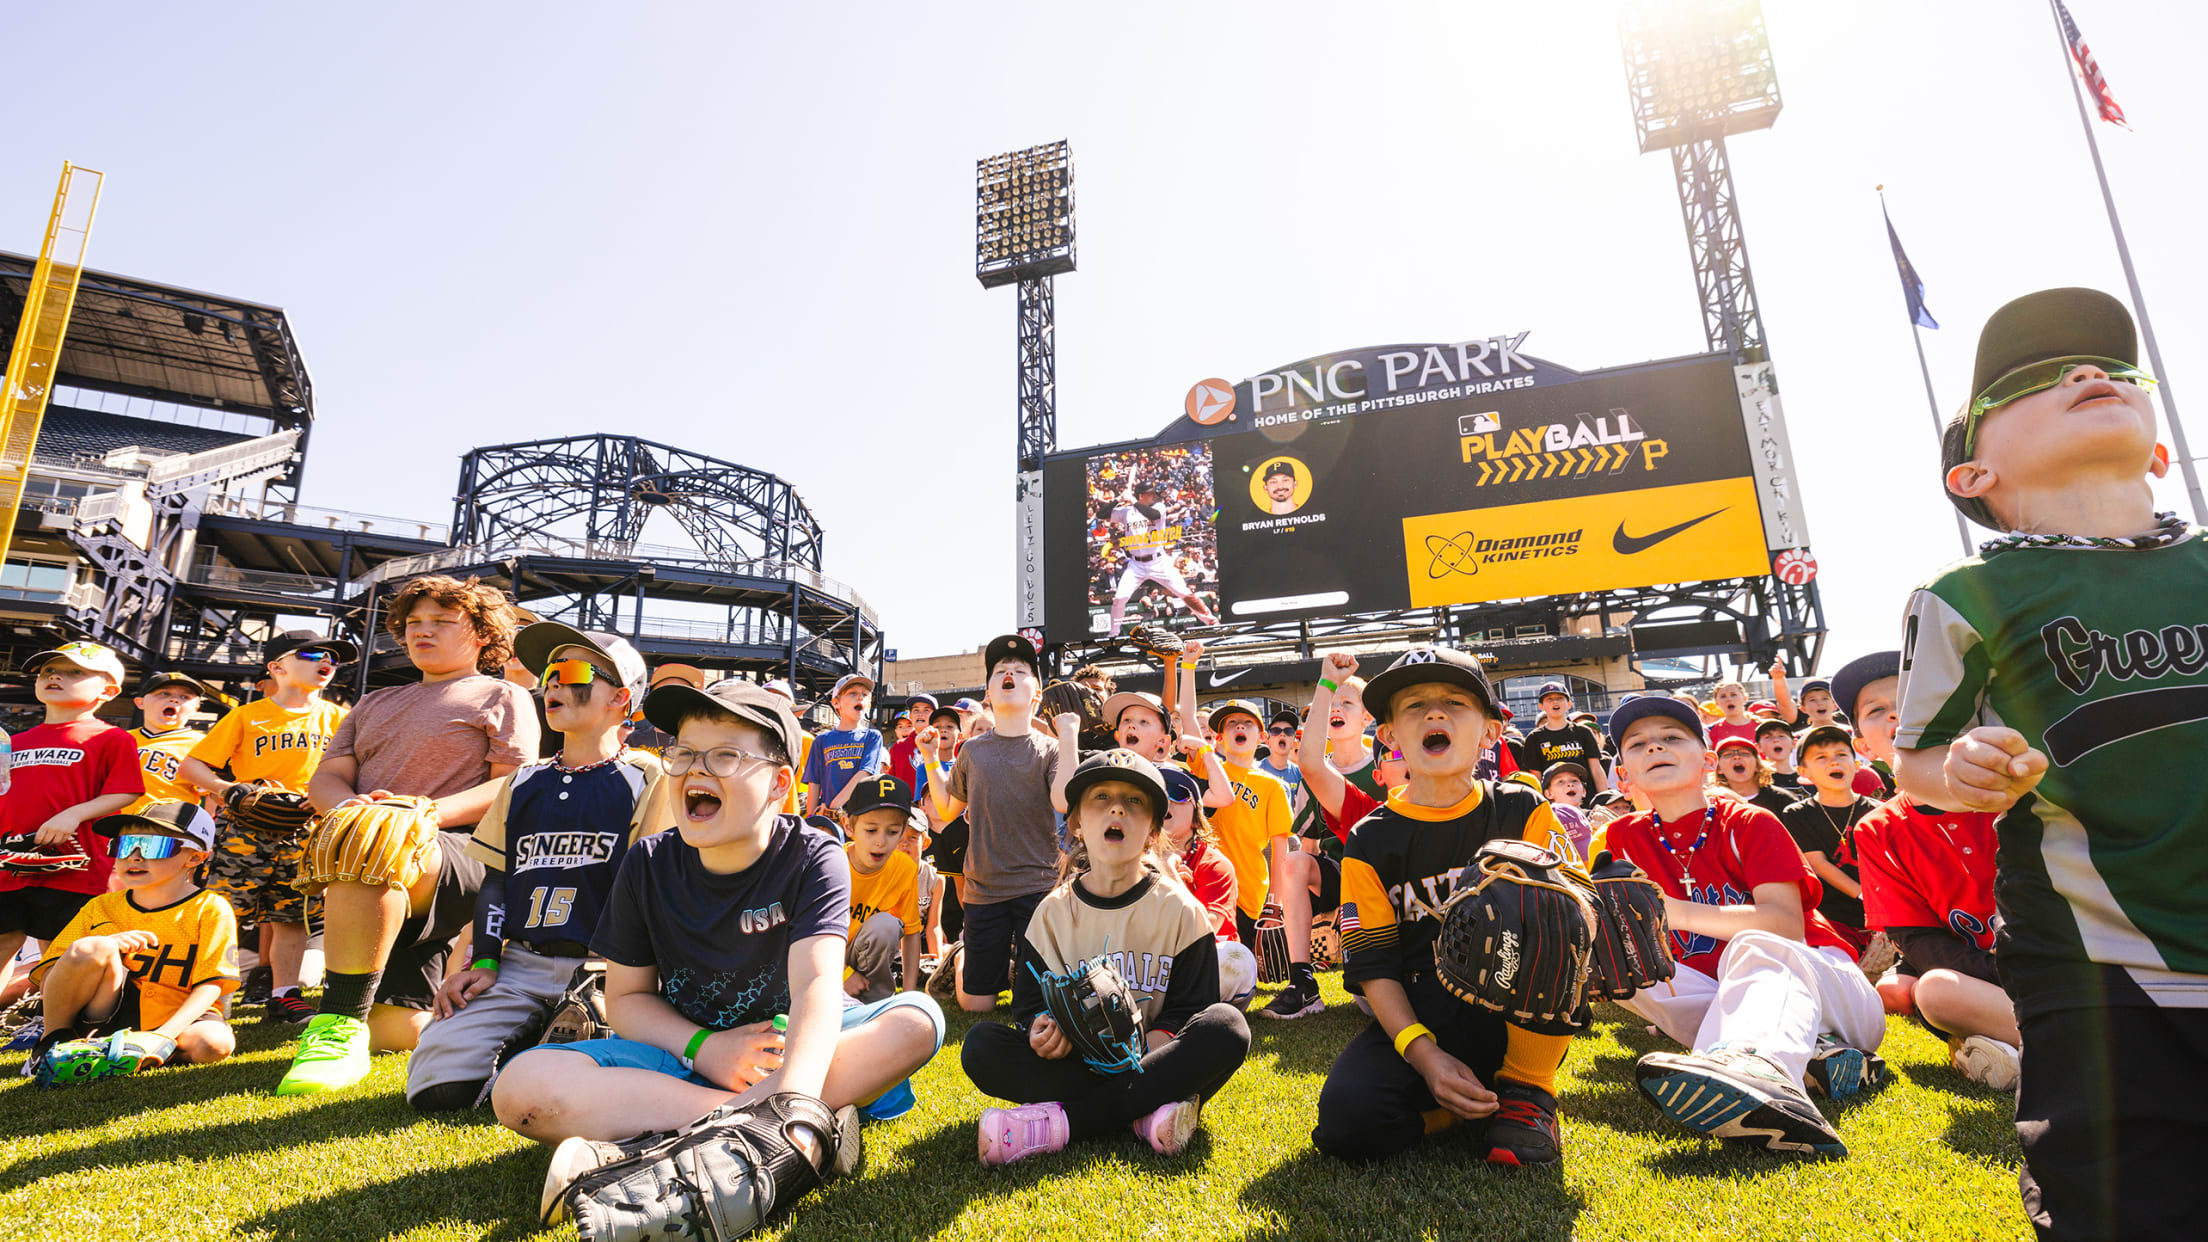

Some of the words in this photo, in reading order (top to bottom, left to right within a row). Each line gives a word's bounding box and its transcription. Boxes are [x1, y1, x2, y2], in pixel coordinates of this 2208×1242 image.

[1246, 359, 1365, 412] PNC
[1378, 330, 1535, 391] PARK
[1255, 412, 1298, 428] HOME
[1302, 408, 1322, 420] OF
[1327, 402, 1357, 416] THE
[1361, 386, 1460, 412] PITTSBURGH
[1466, 375, 1535, 395] PIRATES
[1641, 438, 1669, 471] P
[1119, 532, 1150, 548] SWING
[1150, 525, 1182, 543] MATCH
[1242, 520, 1273, 531] BRYAN
[1276, 513, 1326, 527] REYNOLDS
[1482, 544, 1579, 563] KINETICS
[35, 749, 82, 761] WARD
[255, 733, 331, 757] PIRATE
[138, 748, 180, 781] TES
[879, 779, 896, 798] P
[1230, 781, 1259, 810] TES
[524, 886, 577, 929] 15
[740, 901, 787, 935] USA
[120, 943, 199, 988] GH
[1065, 951, 1174, 996] DALE
[1494, 929, 1520, 990] Rawlings
